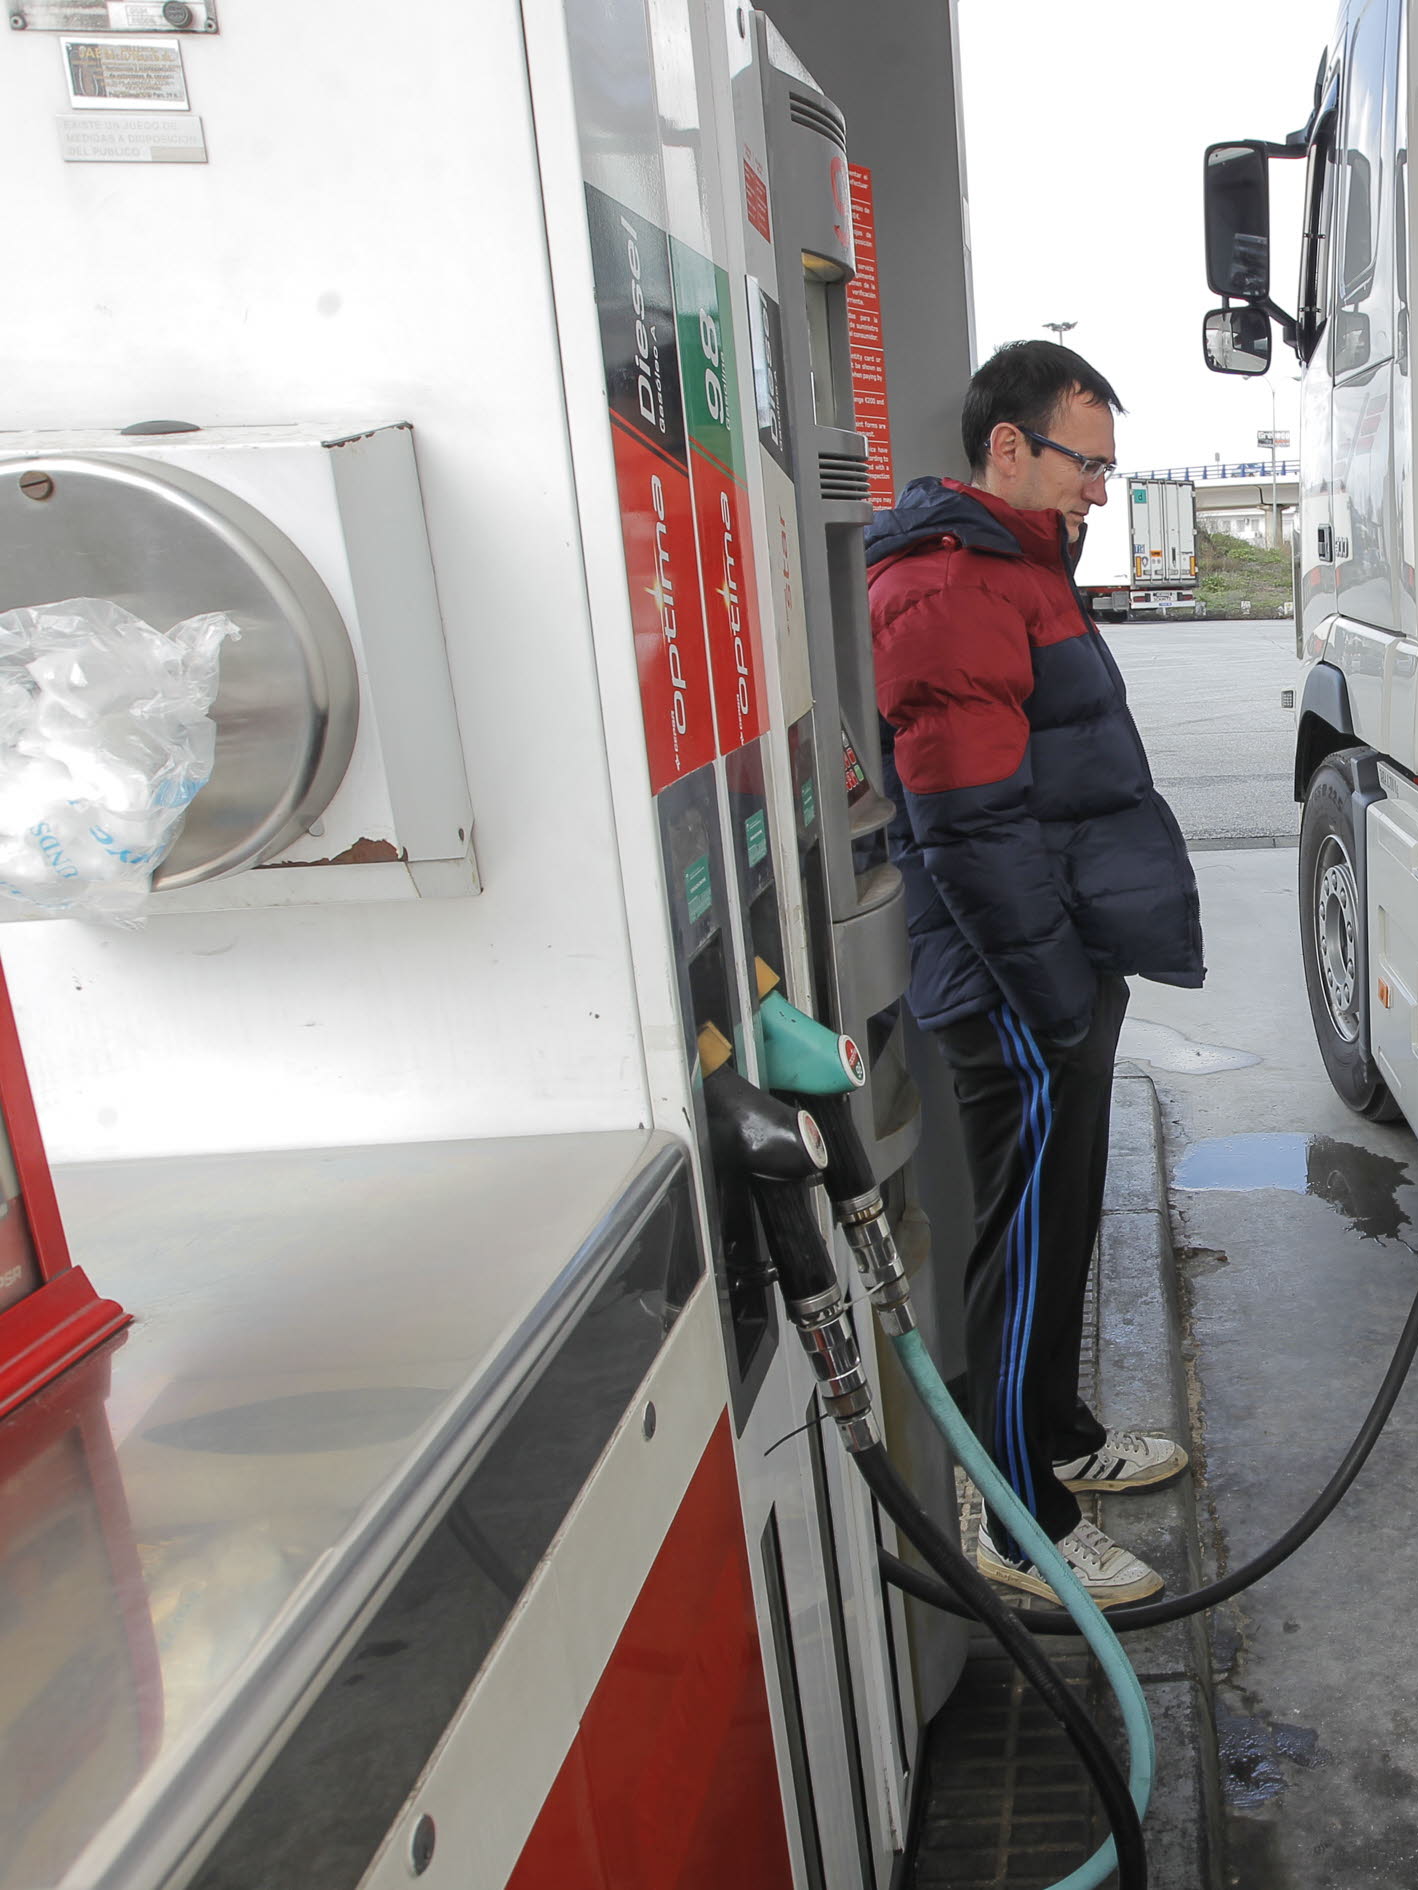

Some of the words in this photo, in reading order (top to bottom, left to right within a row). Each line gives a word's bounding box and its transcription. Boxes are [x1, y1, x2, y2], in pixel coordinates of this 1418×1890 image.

[63, 120, 100, 130] EXISTE
[104, 121, 121, 130] UN
[124, 121, 159, 130] JUEGO
[162, 122, 177, 130] DE
[65, 134, 116, 144] MEDIDAS
[119, 135, 127, 144] A
[68, 147, 90, 156] DEL
[620, 215, 656, 426] Diesel
[700, 307, 724, 425] 98
[651, 474, 687, 735] optima
[720, 491, 749, 716] optima
